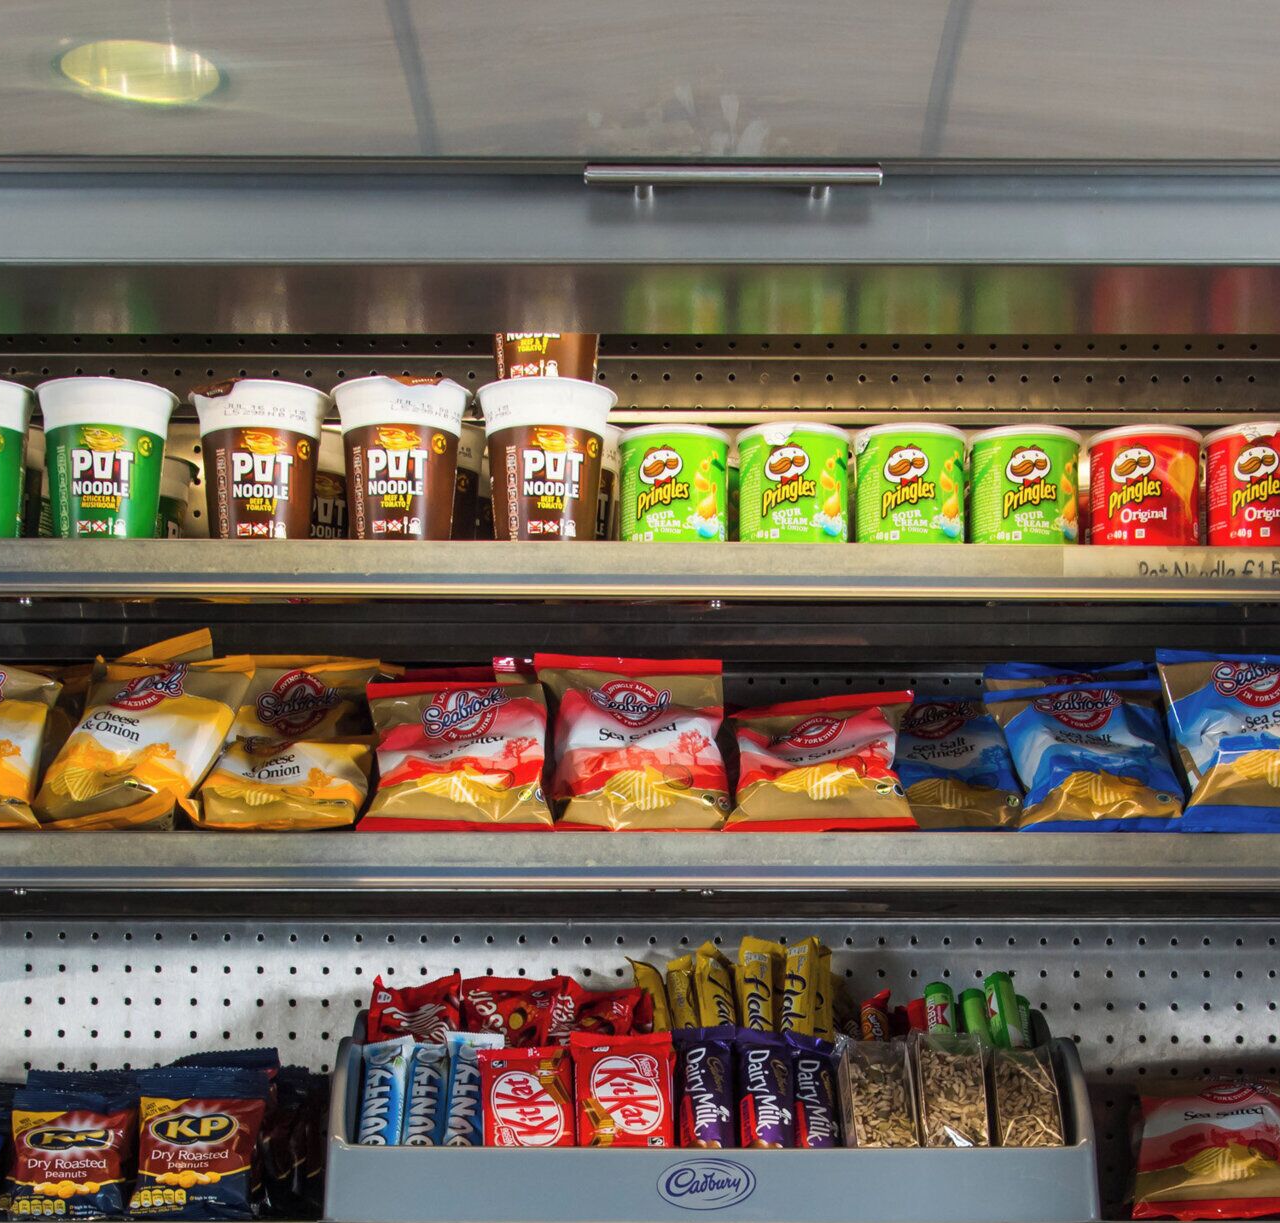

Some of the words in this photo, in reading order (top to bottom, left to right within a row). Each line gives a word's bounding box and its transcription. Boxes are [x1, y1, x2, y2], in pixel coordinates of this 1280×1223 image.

[71, 448, 135, 480] POT
[231, 451, 294, 483] POT
[367, 449, 428, 479] POT
[522, 449, 584, 480] POT
[72, 480, 130, 497] NOODLE
[232, 483, 289, 500] NOODLE
[368, 480, 424, 496] NOODLE
[523, 481, 580, 498] NOODLE
[762, 475, 816, 518] Pringles
[637, 477, 690, 521] Pringles
[881, 477, 936, 519] Pringles
[1003, 479, 1057, 519] Pringles
[1108, 476, 1162, 519] Pringles
[646, 510, 674, 522] SOUR
[648, 518, 681, 528] CREAM
[772, 508, 801, 521] SOUR
[774, 516, 808, 526] CREAM
[892, 509, 921, 522] SOUR
[894, 518, 928, 527] CREAM
[1014, 511, 1044, 523] SOUR
[1120, 507, 1167, 524] Original
[660, 527, 682, 535] ONION
[787, 524, 808, 533] ONION
[907, 526, 929, 534] ONION
[1016, 518, 1050, 529] CREAM
[1029, 527, 1051, 535] ONION
[606, 682, 633, 698] LOVINGLY
[636, 684, 655, 698] MADE
[93, 710, 140, 727] Cheese
[422, 688, 509, 738] Seabrook
[1245, 713, 1272, 730] Sea
[81, 719, 94, 730] &
[95, 721, 140, 742] Onion
[458, 712, 494, 740] YORKSHIRE
[599, 727, 625, 742] Sea
[803, 722, 841, 745] YORKSHIRE
[943, 737, 966, 750] Salt
[920, 743, 976, 762] Vinegar
[258, 764, 300, 779] Onion
[686, 1047, 707, 1094] Dairy
[747, 1050, 770, 1097] Dairy
[797, 1059, 820, 1103] Dairy
[693, 1093, 718, 1137] Milk
[756, 1094, 777, 1136] Milk
[1184, 1110, 1211, 1121] Sea
[165, 1116, 229, 1139] KP
[807, 1102, 830, 1146] Milk
[41, 1129, 107, 1144] KP
[151, 1150, 174, 1161] Dry
[178, 1149, 229, 1161] Roasted
[27, 1158, 51, 1171] Dry
[55, 1158, 107, 1169] Roasted
[167, 1160, 209, 1171] peanuts
[45, 1170, 87, 1179] peanuts
[665, 1168, 742, 1197] Cadbury
